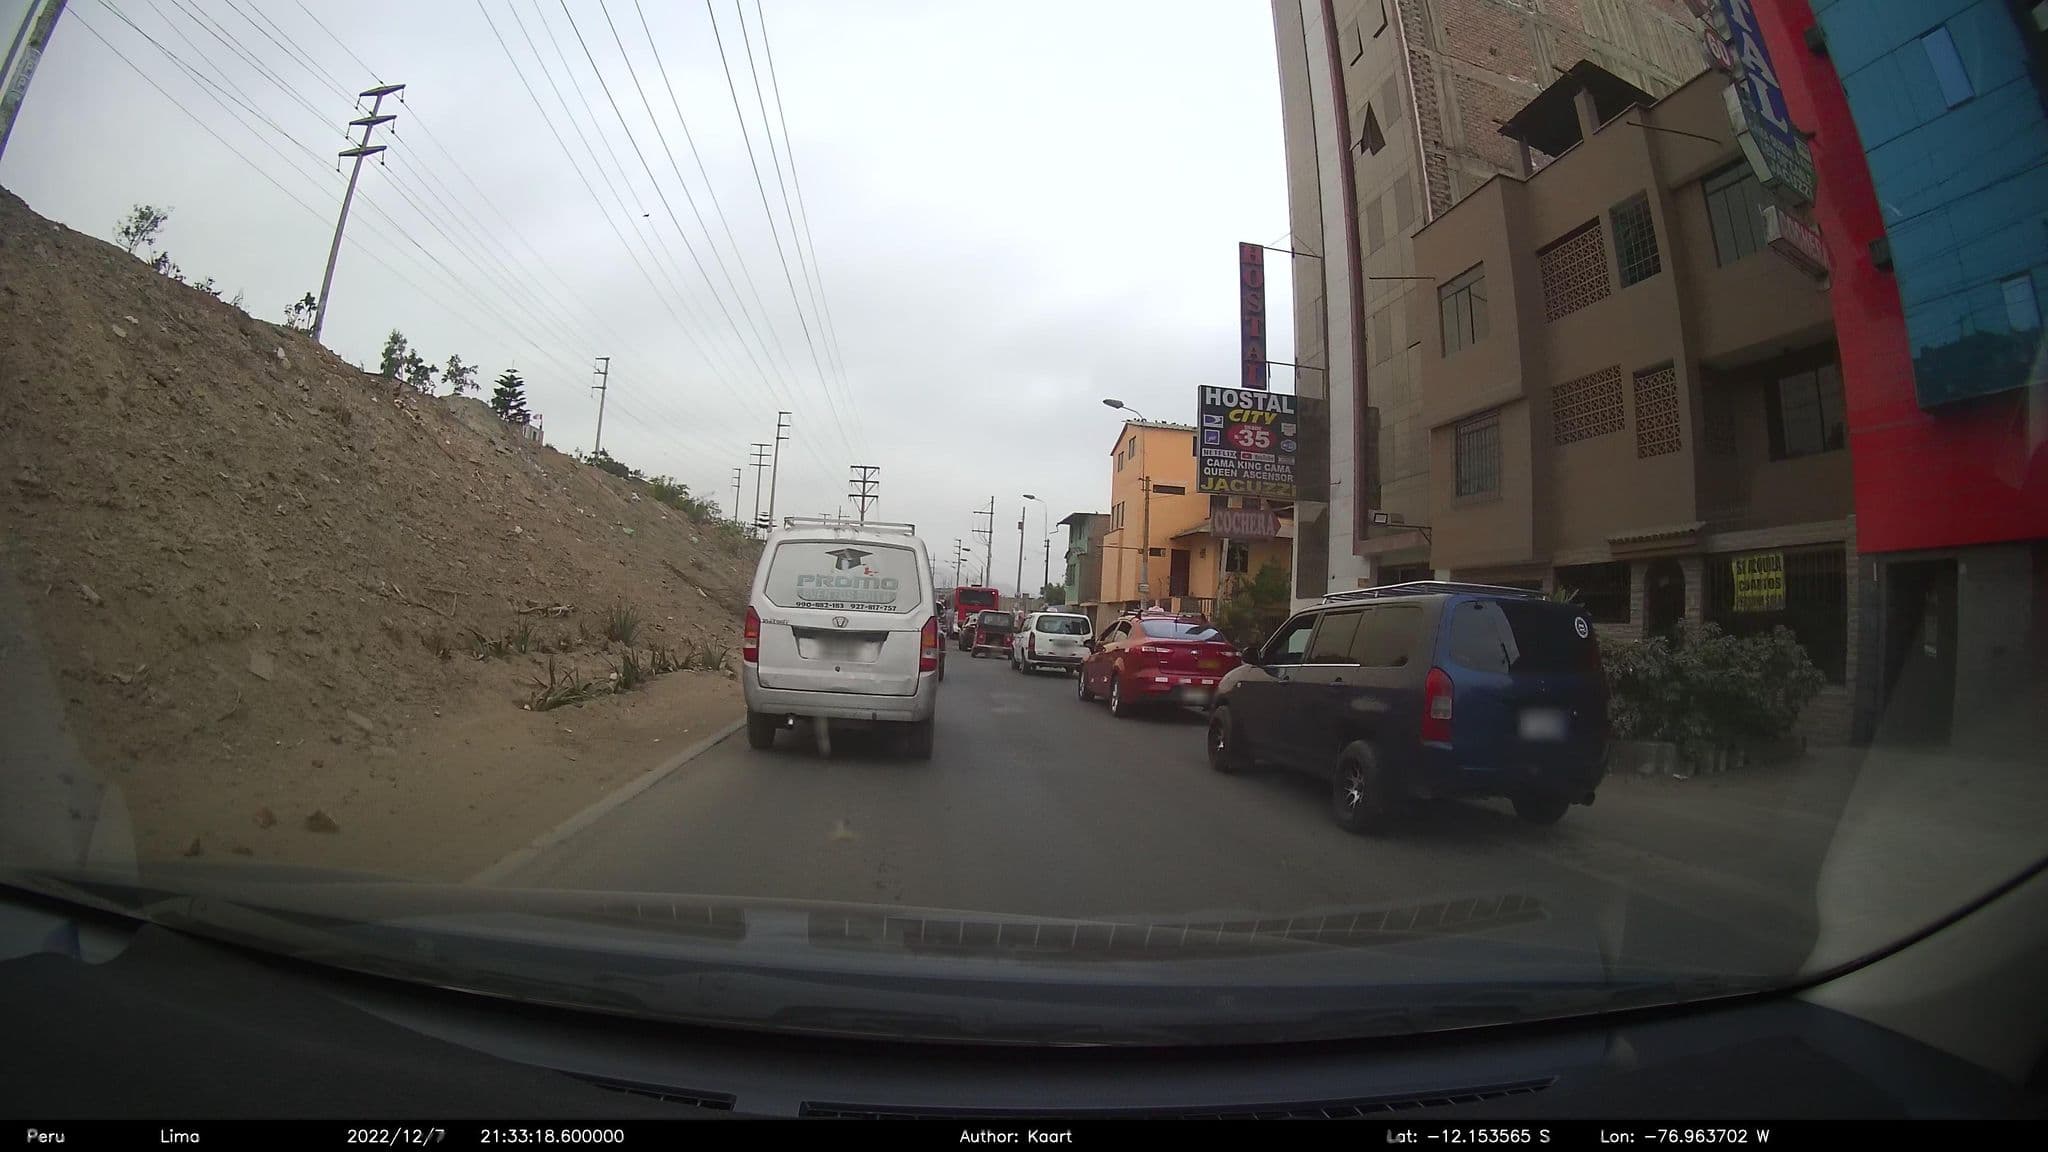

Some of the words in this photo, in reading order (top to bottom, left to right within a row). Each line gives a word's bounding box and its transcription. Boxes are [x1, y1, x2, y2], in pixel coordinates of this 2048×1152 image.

[1205, 387, 1295, 414] HOSTAL
[1228, 409, 1278, 425] CITY
[1238, 429, 1271, 449] 35
[1206, 458, 1235, 469] CAMA
[1237, 461, 1262, 470] KING
[1264, 463, 1292, 474] CAMA
[1203, 467, 1238, 477] QUEEN
[1242, 470, 1294, 482] ASCENSOR
[1214, 511, 1276, 537] COCHERA
[797, 574, 899, 590] PROMO
